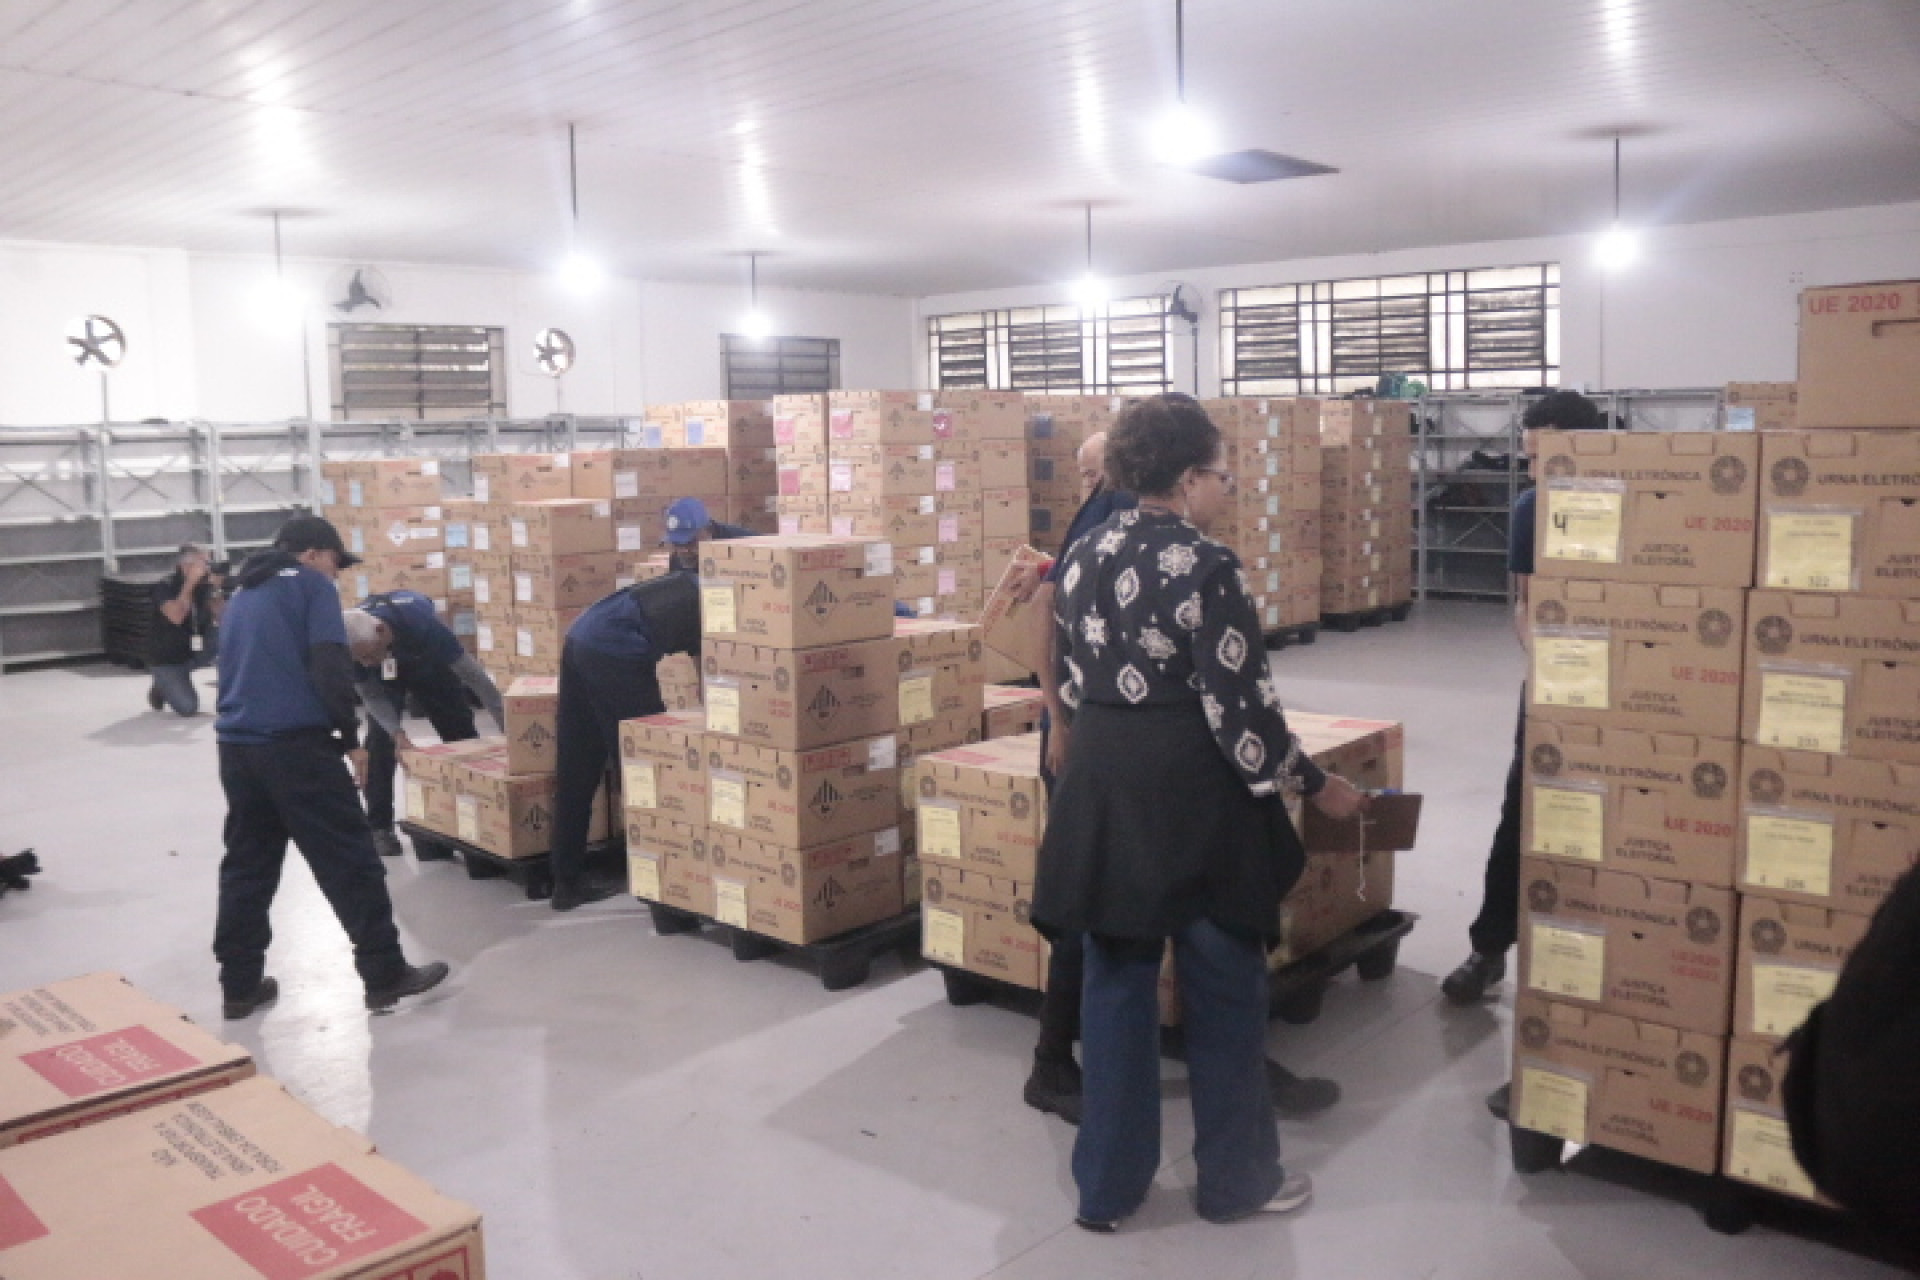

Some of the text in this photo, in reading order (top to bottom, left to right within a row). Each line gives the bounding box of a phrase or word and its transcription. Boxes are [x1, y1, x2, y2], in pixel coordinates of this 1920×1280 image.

[1807, 293, 1902, 315] UE 2020
[1816, 474, 1859, 486] URNA
[1685, 516, 1752, 532] UE 2020
[1671, 666, 1738, 685] UE 2020
[1663, 815, 1732, 838] UE 2020
[1650, 1098, 1713, 1123] UE 2020
[290, 1183, 378, 1243] FRÁGIL
[234, 1196, 339, 1266] CUIDADO
